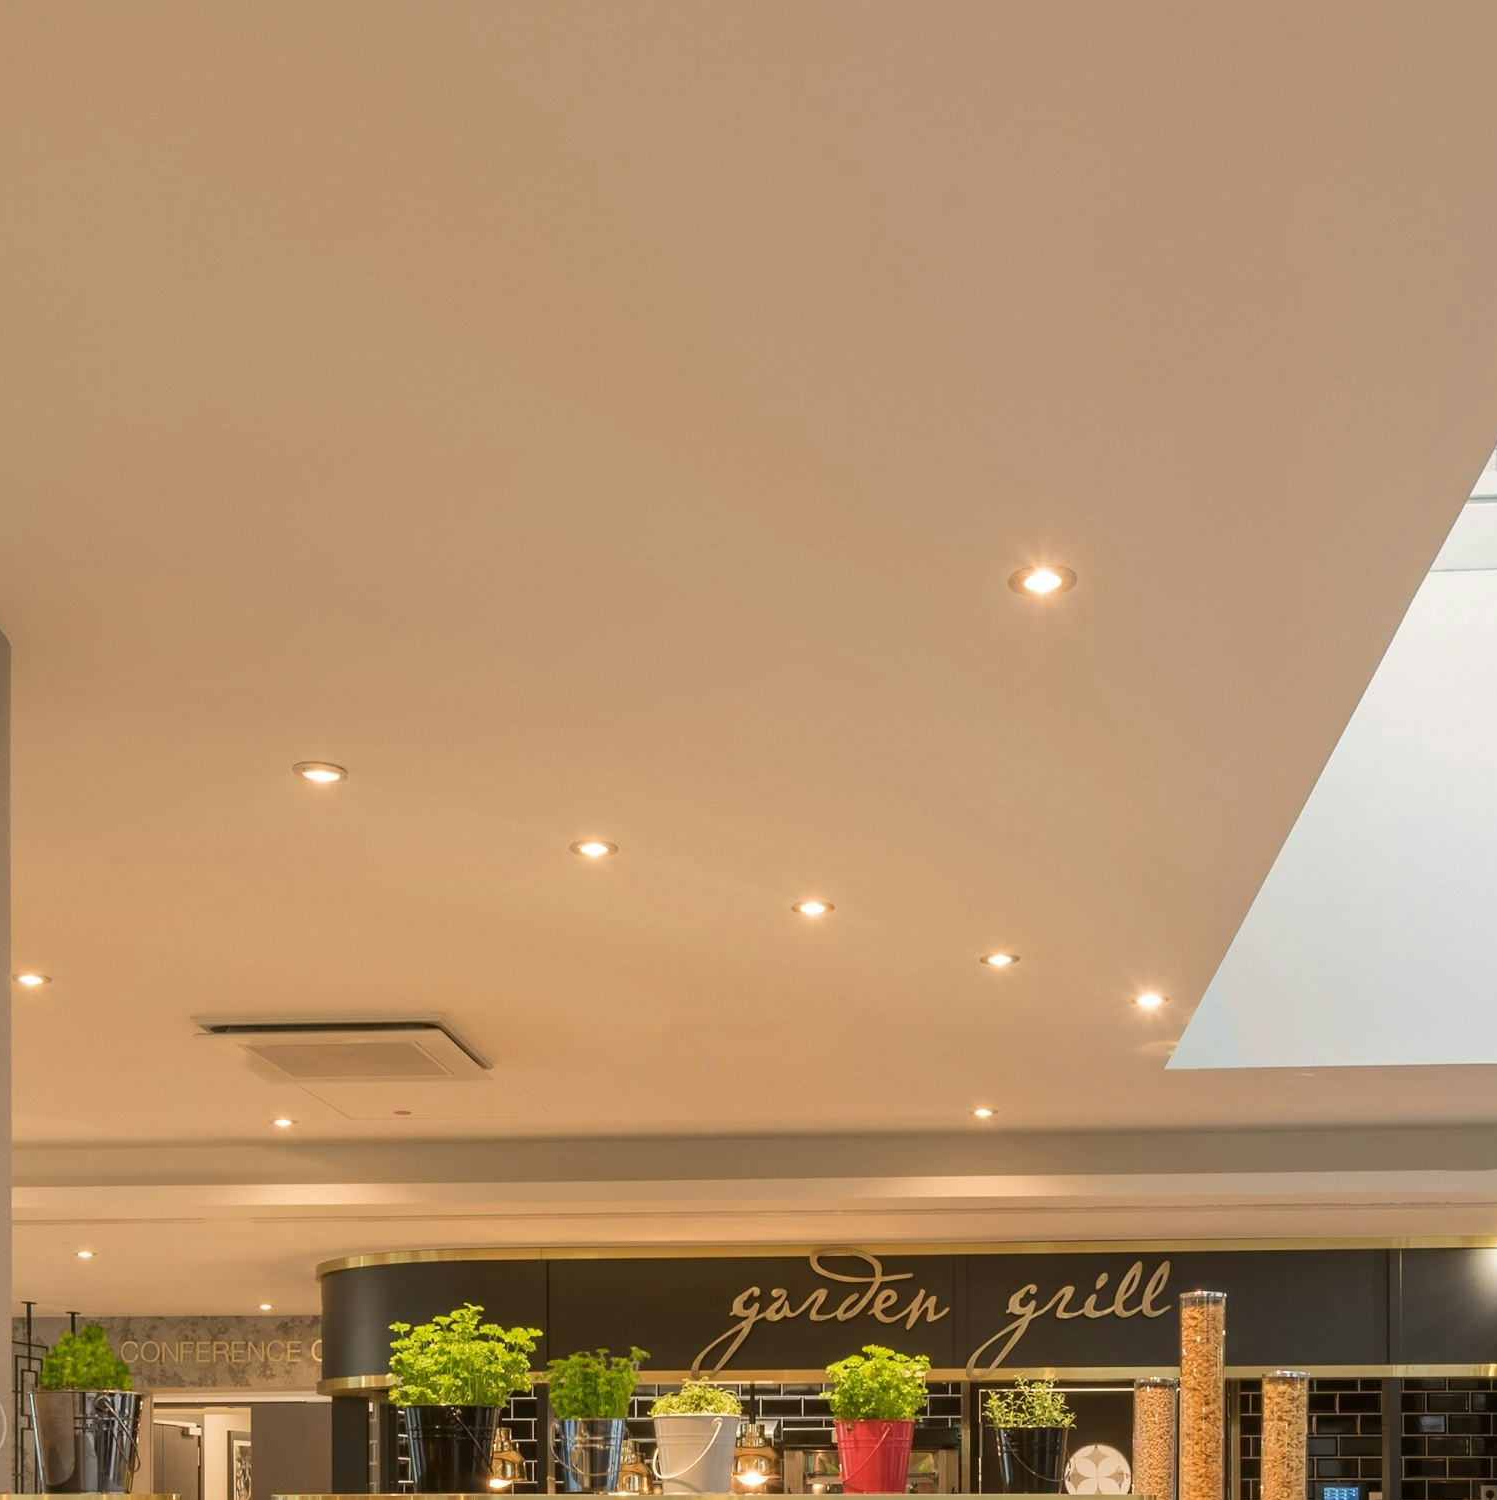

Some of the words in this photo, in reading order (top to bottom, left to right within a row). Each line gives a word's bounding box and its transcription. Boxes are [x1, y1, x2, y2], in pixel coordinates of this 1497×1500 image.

[120, 1340, 302, 1363] CONFERENCE
[691, 1247, 950, 1380] garden
[966, 1260, 1171, 1379] grill
